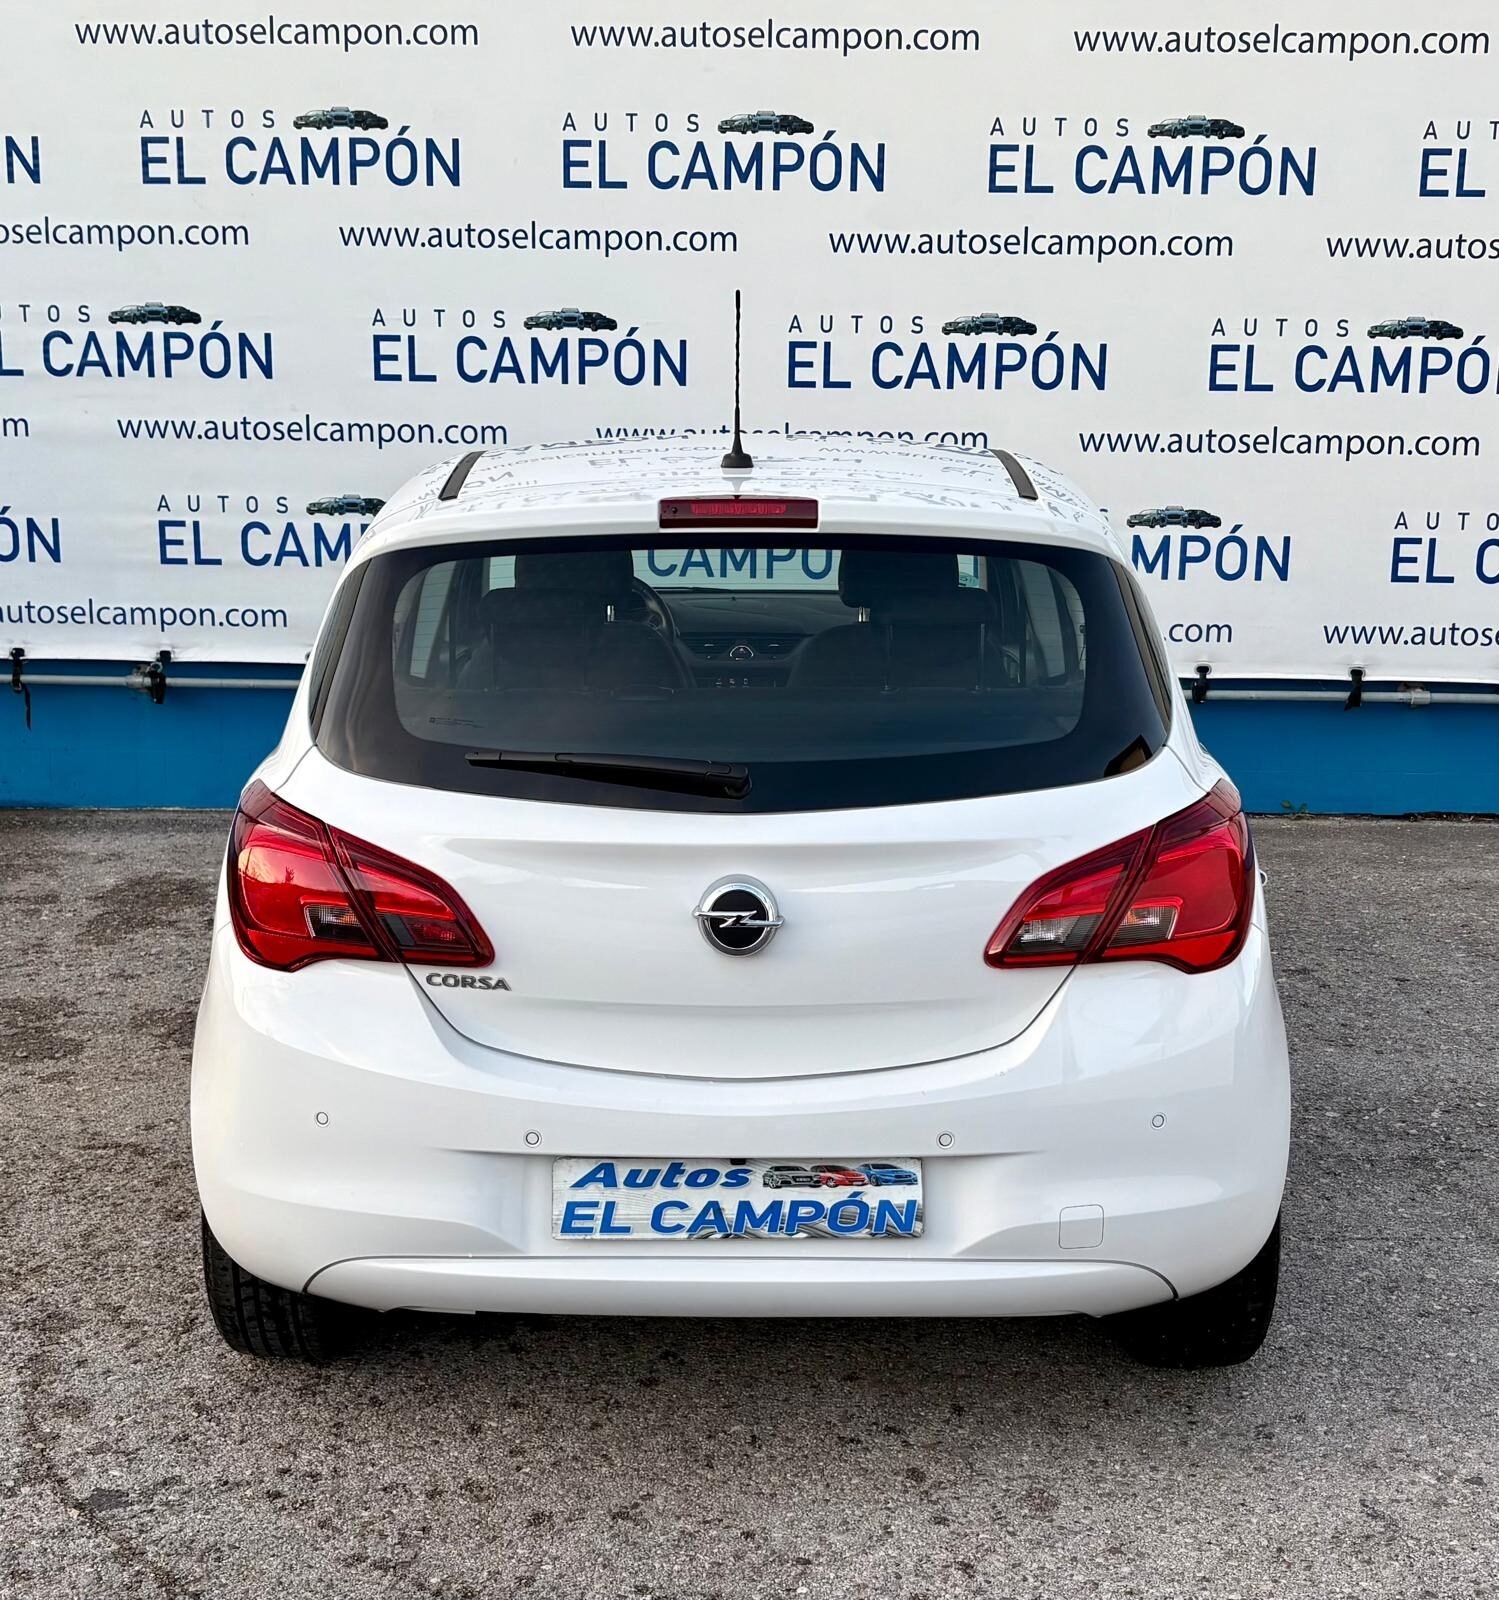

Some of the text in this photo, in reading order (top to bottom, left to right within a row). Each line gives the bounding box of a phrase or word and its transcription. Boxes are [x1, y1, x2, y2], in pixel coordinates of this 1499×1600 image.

[75, 15, 478, 52] www.autoselcampon.com
[571, 19, 979, 56] www.autoselcampon.com
[1074, 24, 1489, 61] www.autoselcampon.com
[140, 110, 274, 128] AUTOS
[563, 113, 699, 132] AUTOS
[990, 117, 1128, 137] AUTOS
[141, 125, 460, 186] EL CAMPÓN
[563, 130, 885, 192] EL CAMPÓN
[989, 134, 1316, 196] EL CAMPÓN
[1419, 148, 1485, 197] EL
[339, 221, 736, 257] www.autoselcampon.com
[829, 226, 1232, 263] www.autoselcampon.com
[0, 305, 90, 322] TOS
[372, 309, 505, 328] AUTOS
[789, 315, 923, 334] AUTOS
[1212, 318, 1348, 337] AUTOS
[43, 321, 273, 379] CAMPÓN
[373, 327, 686, 386] EL CAMPÓN
[788, 331, 1107, 390] EL CAMPÓN
[1209, 335, 1499, 394] EL CAMPÓ
[117, 414, 507, 449] www.autoselcampon.com
[1079, 426, 1479, 461] www.autoselcampon.com
[157, 495, 288, 513] AUTOS
[159, 520, 370, 567] EL CAM
[1391, 537, 1455, 583] EL
[0, 598, 287, 632] utoselcampon.com
[1324, 623, 1499, 646] www.autos
[426, 973, 512, 991] CORSA
[568, 1161, 752, 1189] Autos
[560, 1191, 918, 1234] EL CAMPÓN
